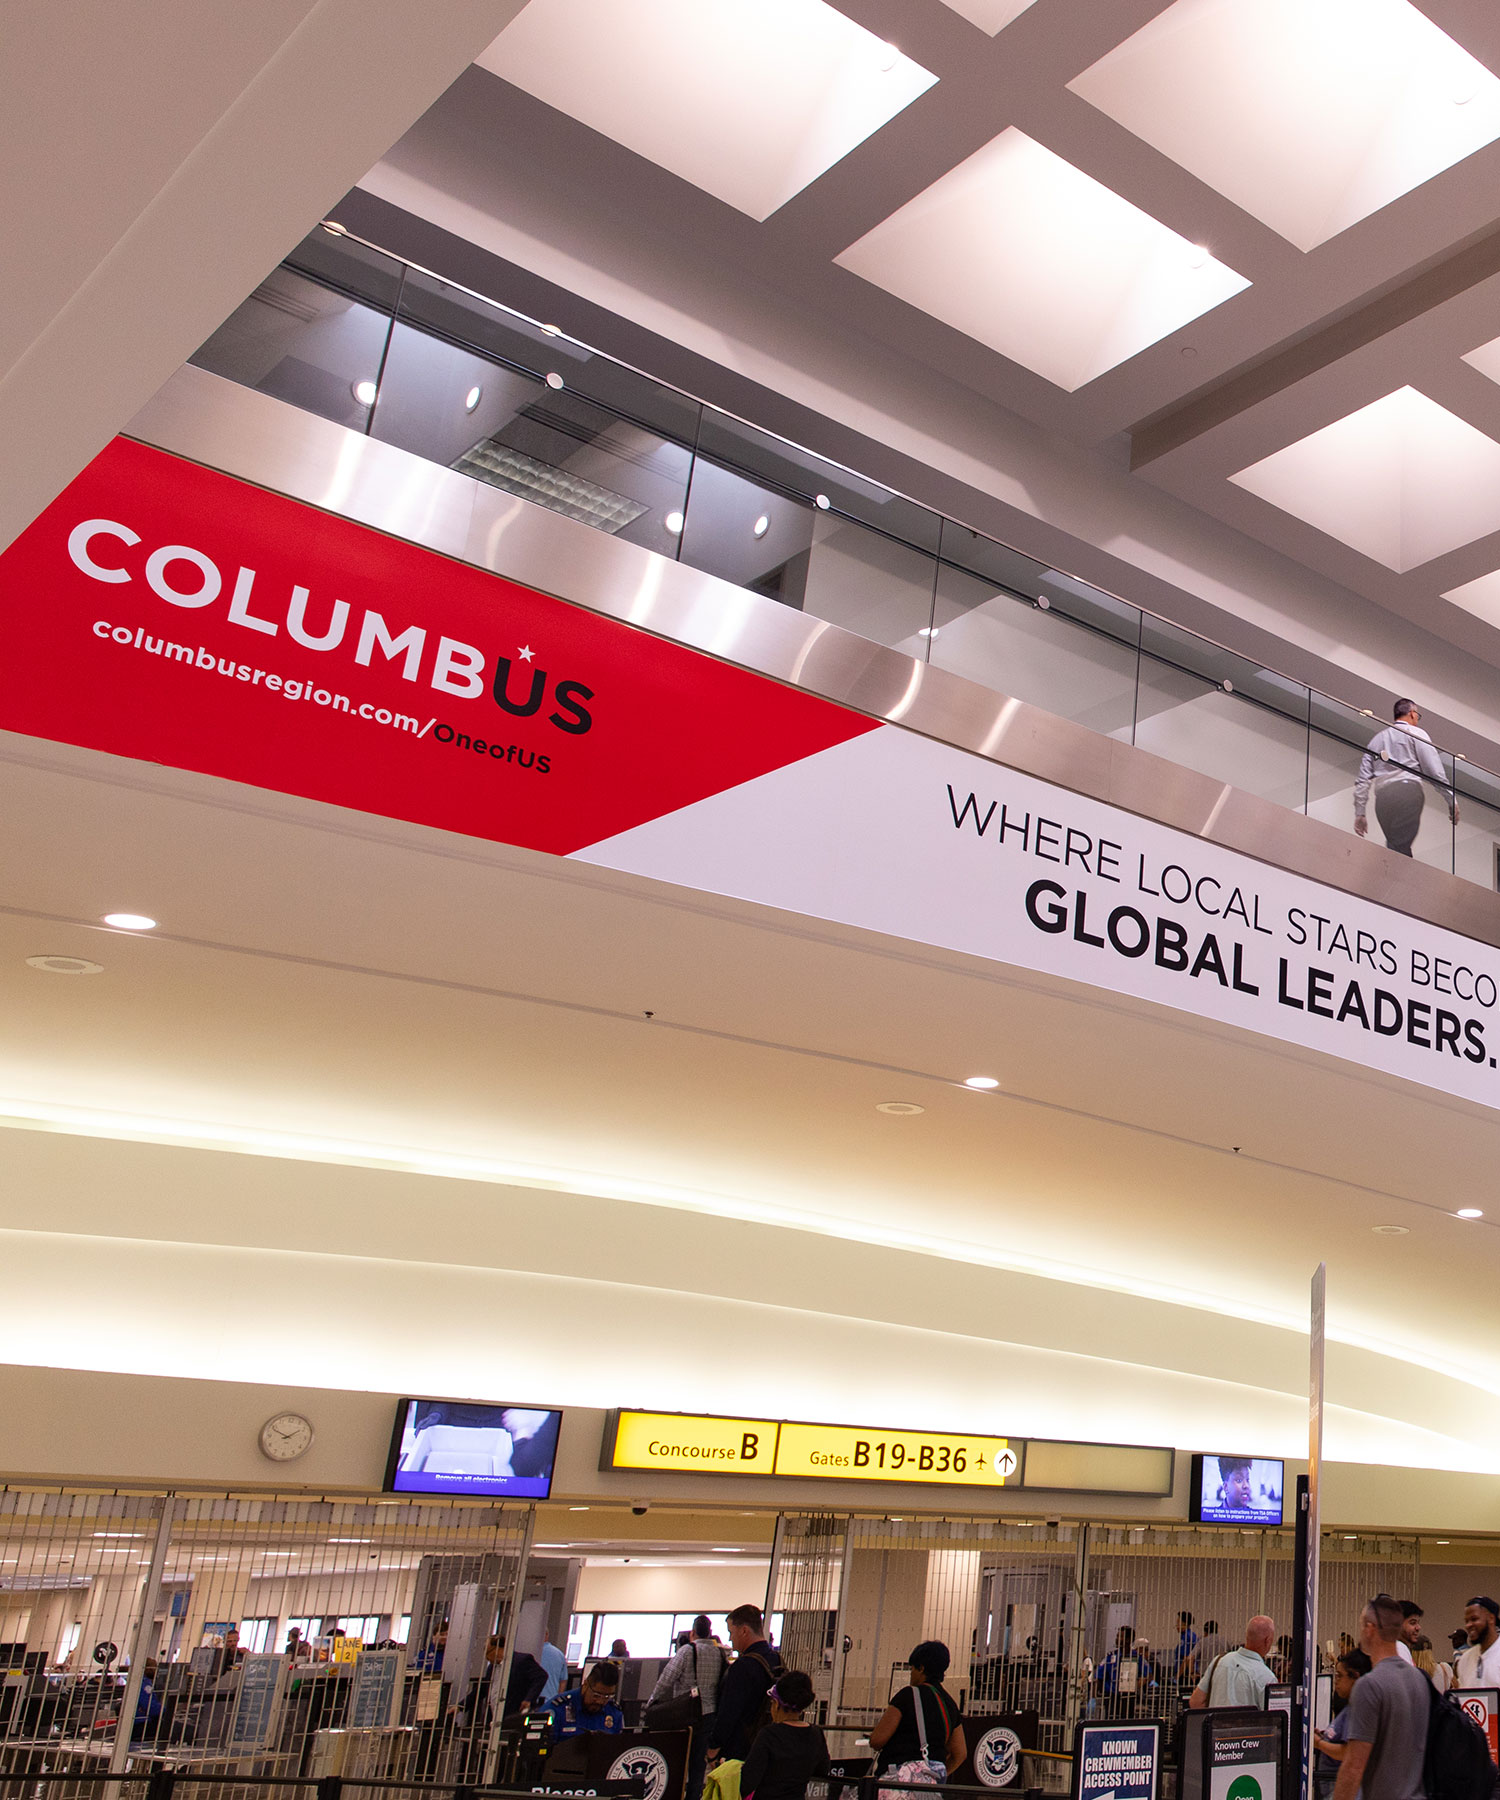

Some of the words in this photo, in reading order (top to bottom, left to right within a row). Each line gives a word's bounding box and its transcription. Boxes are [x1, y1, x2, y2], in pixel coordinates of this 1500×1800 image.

[67, 518, 595, 735] COLUMBUS
[92, 620, 552, 774] columbusregion.com/OneofUS
[946, 784, 1121, 883] WHERE
[1139, 853, 1272, 935] LOCAL
[1287, 907, 1398, 975] STARS
[1025, 879, 1259, 996] GLOBAL
[1279, 958, 1498, 1069] LEADERS.
[648, 1440, 736, 1461] Concourse
[741, 1432, 760, 1461] B
[810, 1450, 850, 1468] Gates
[853, 1441, 968, 1474] B19-B36
[337, 1639, 361, 1649] LANE
[344, 1651, 351, 1660] 2
[1102, 1740, 1138, 1756] KNOWN
[1214, 1740, 1240, 1751] Known
[1241, 1740, 1260, 1749] Crew
[624, 1750, 663, 1767] DEPARTMENT
[1084, 1755, 1152, 1773] CREWMEMBER
[1214, 1752, 1244, 1762] Member
[1084, 1772, 1122, 1788] ACCESS
[1124, 1771, 1152, 1787] POINT
[532, 1786, 596, 1796] Please
